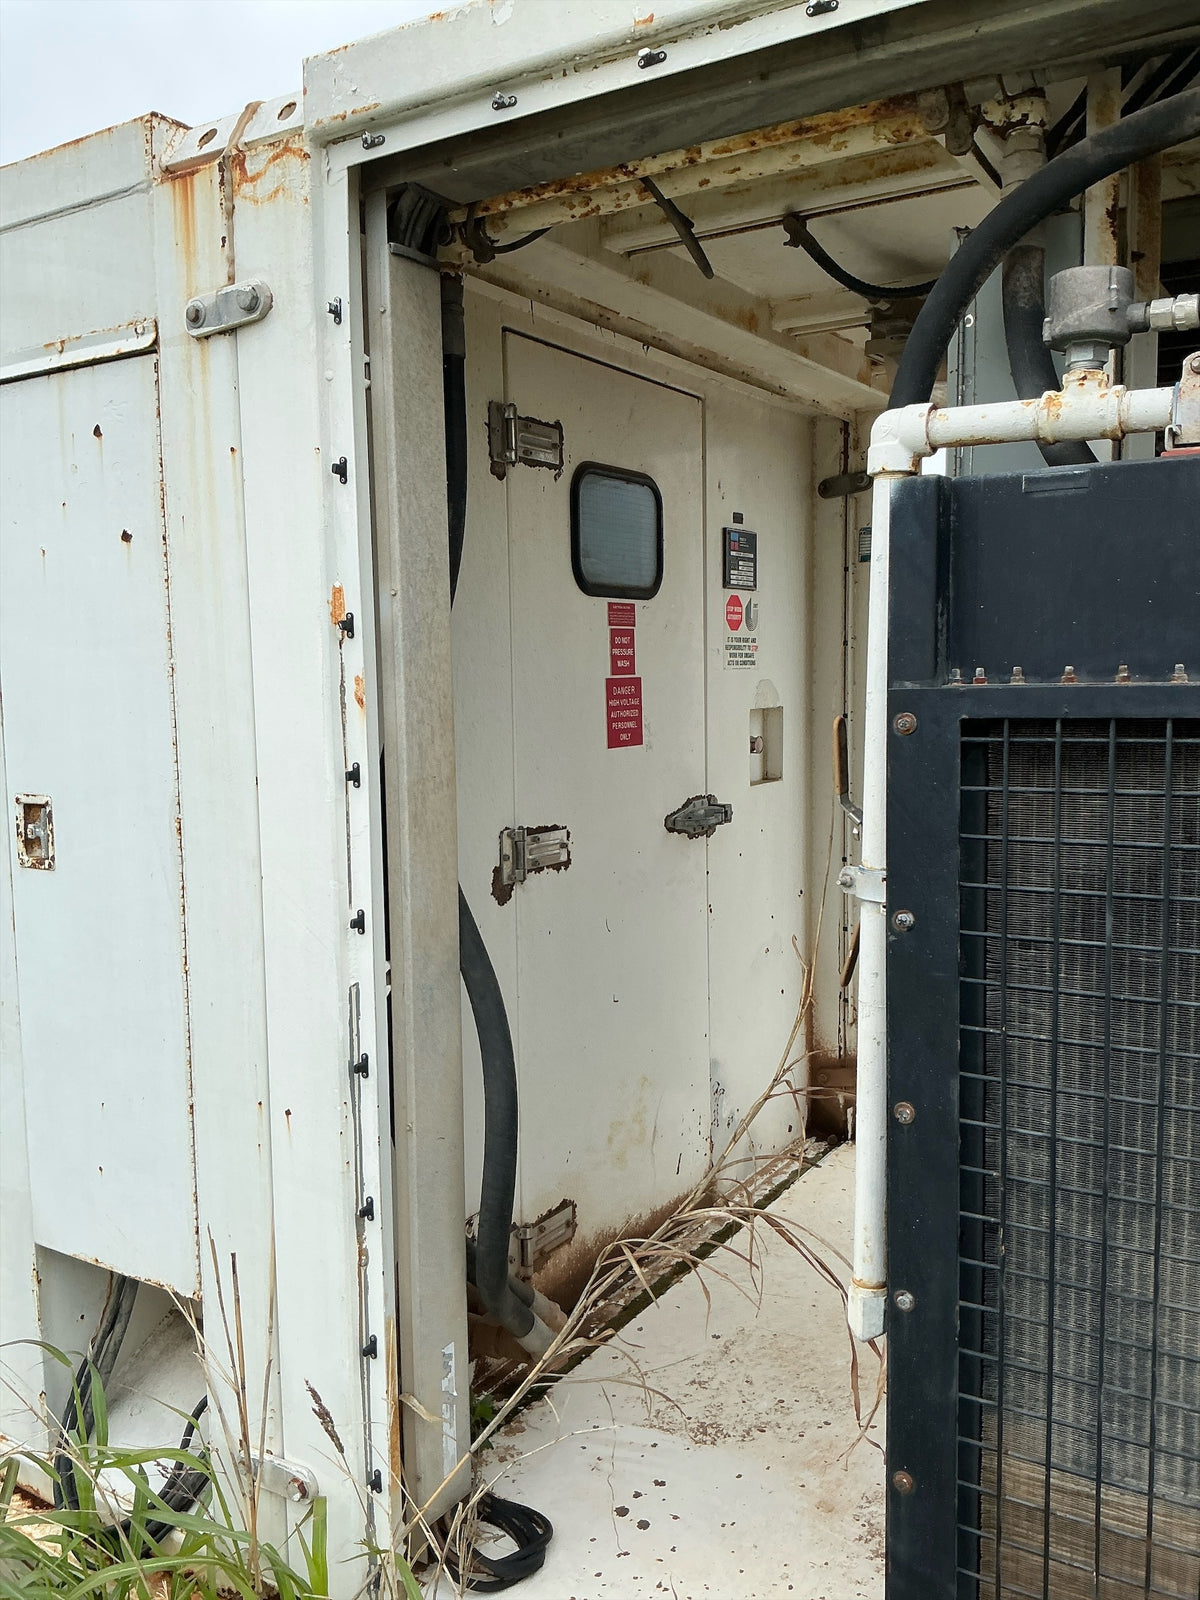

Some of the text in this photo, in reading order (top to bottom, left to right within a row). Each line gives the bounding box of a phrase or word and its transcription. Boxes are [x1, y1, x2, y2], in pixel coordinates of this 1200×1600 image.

[612, 686, 636, 696] DANGER
[611, 710, 639, 718] AUTHORIZED
[612, 721, 637, 729] PERSONNEL
